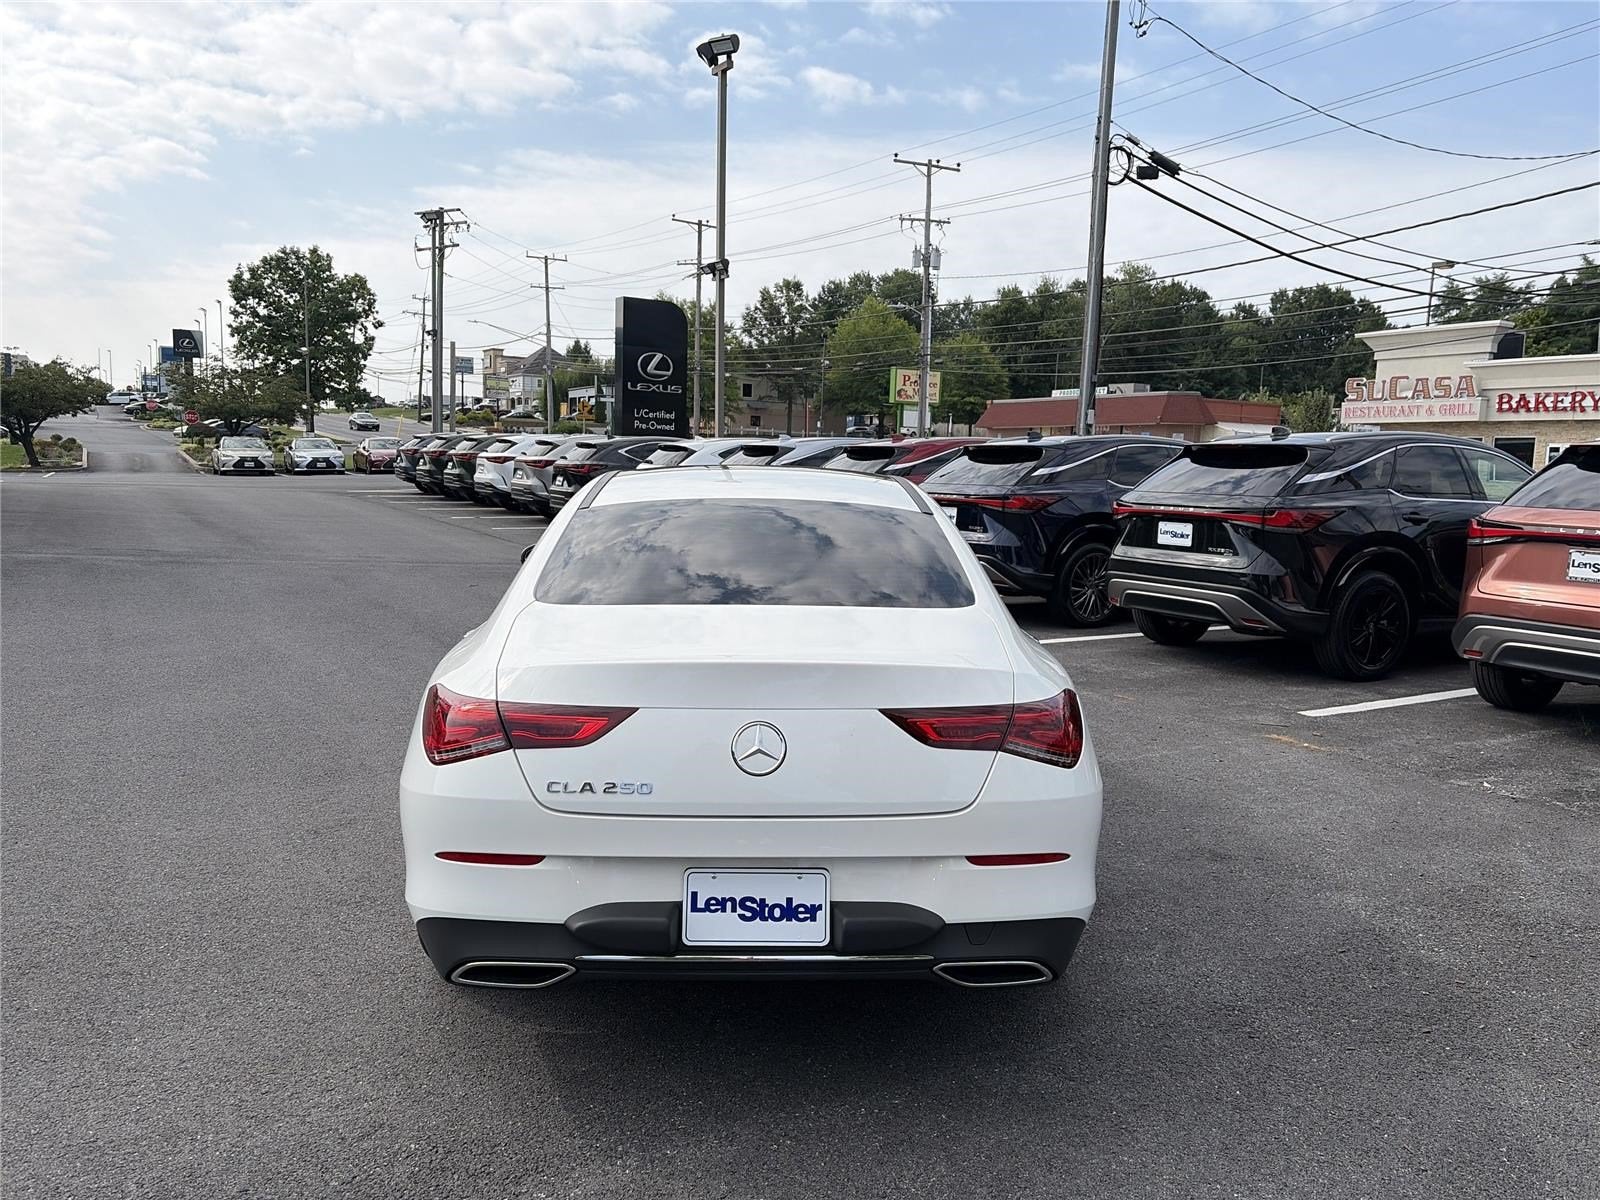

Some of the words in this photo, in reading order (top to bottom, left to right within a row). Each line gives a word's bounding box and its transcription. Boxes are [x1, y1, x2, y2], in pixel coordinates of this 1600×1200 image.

[627, 382, 682, 394] LEXUS
[902, 374, 938, 388] Proce
[1496, 391, 1600, 413] BAKERY
[634, 408, 675, 420] L/Certified
[1344, 404, 1424, 418] RESTAURANT
[1425, 405, 1435, 417] &
[1439, 403, 1477, 417] GRILL
[634, 420, 675, 431] Pre-Owned
[546, 781, 597, 794] CLA
[603, 782, 653, 795] 250
